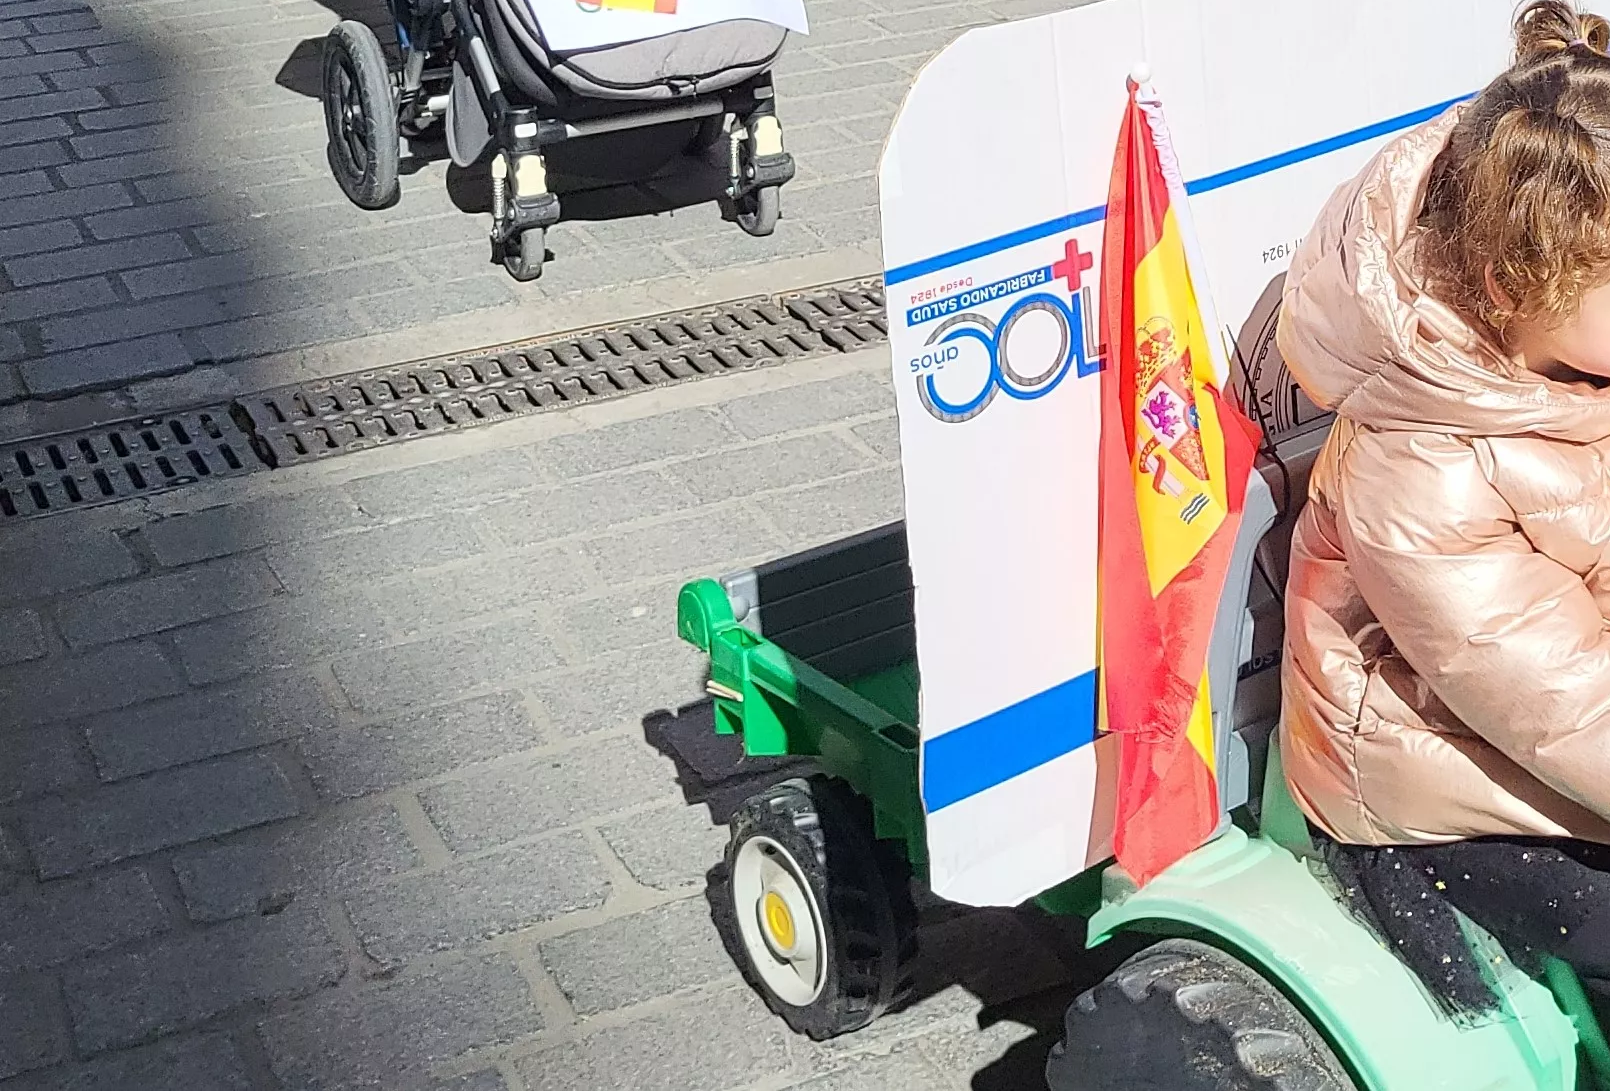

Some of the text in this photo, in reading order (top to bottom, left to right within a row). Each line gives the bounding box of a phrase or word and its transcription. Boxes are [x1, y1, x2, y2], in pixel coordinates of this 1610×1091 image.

[1262, 243, 1291, 264] 1924
[910, 268, 1047, 323] FABRICANDO SALUD
[939, 277, 974, 295] Desde
[909, 345, 960, 373] años
